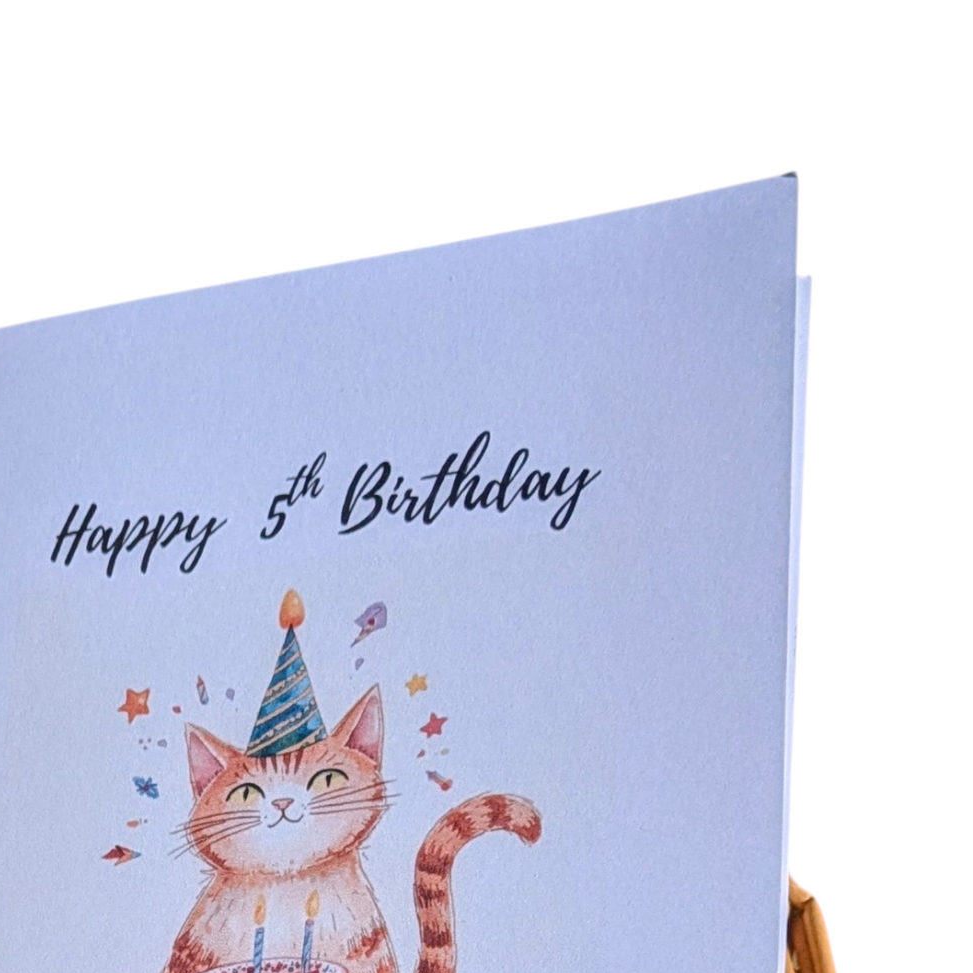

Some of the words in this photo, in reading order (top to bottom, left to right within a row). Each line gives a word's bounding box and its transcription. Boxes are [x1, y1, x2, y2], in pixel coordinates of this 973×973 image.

[50, 502, 228, 578] Happy
[259, 451, 327, 540] 5th
[338, 430, 602, 536] Birthday
